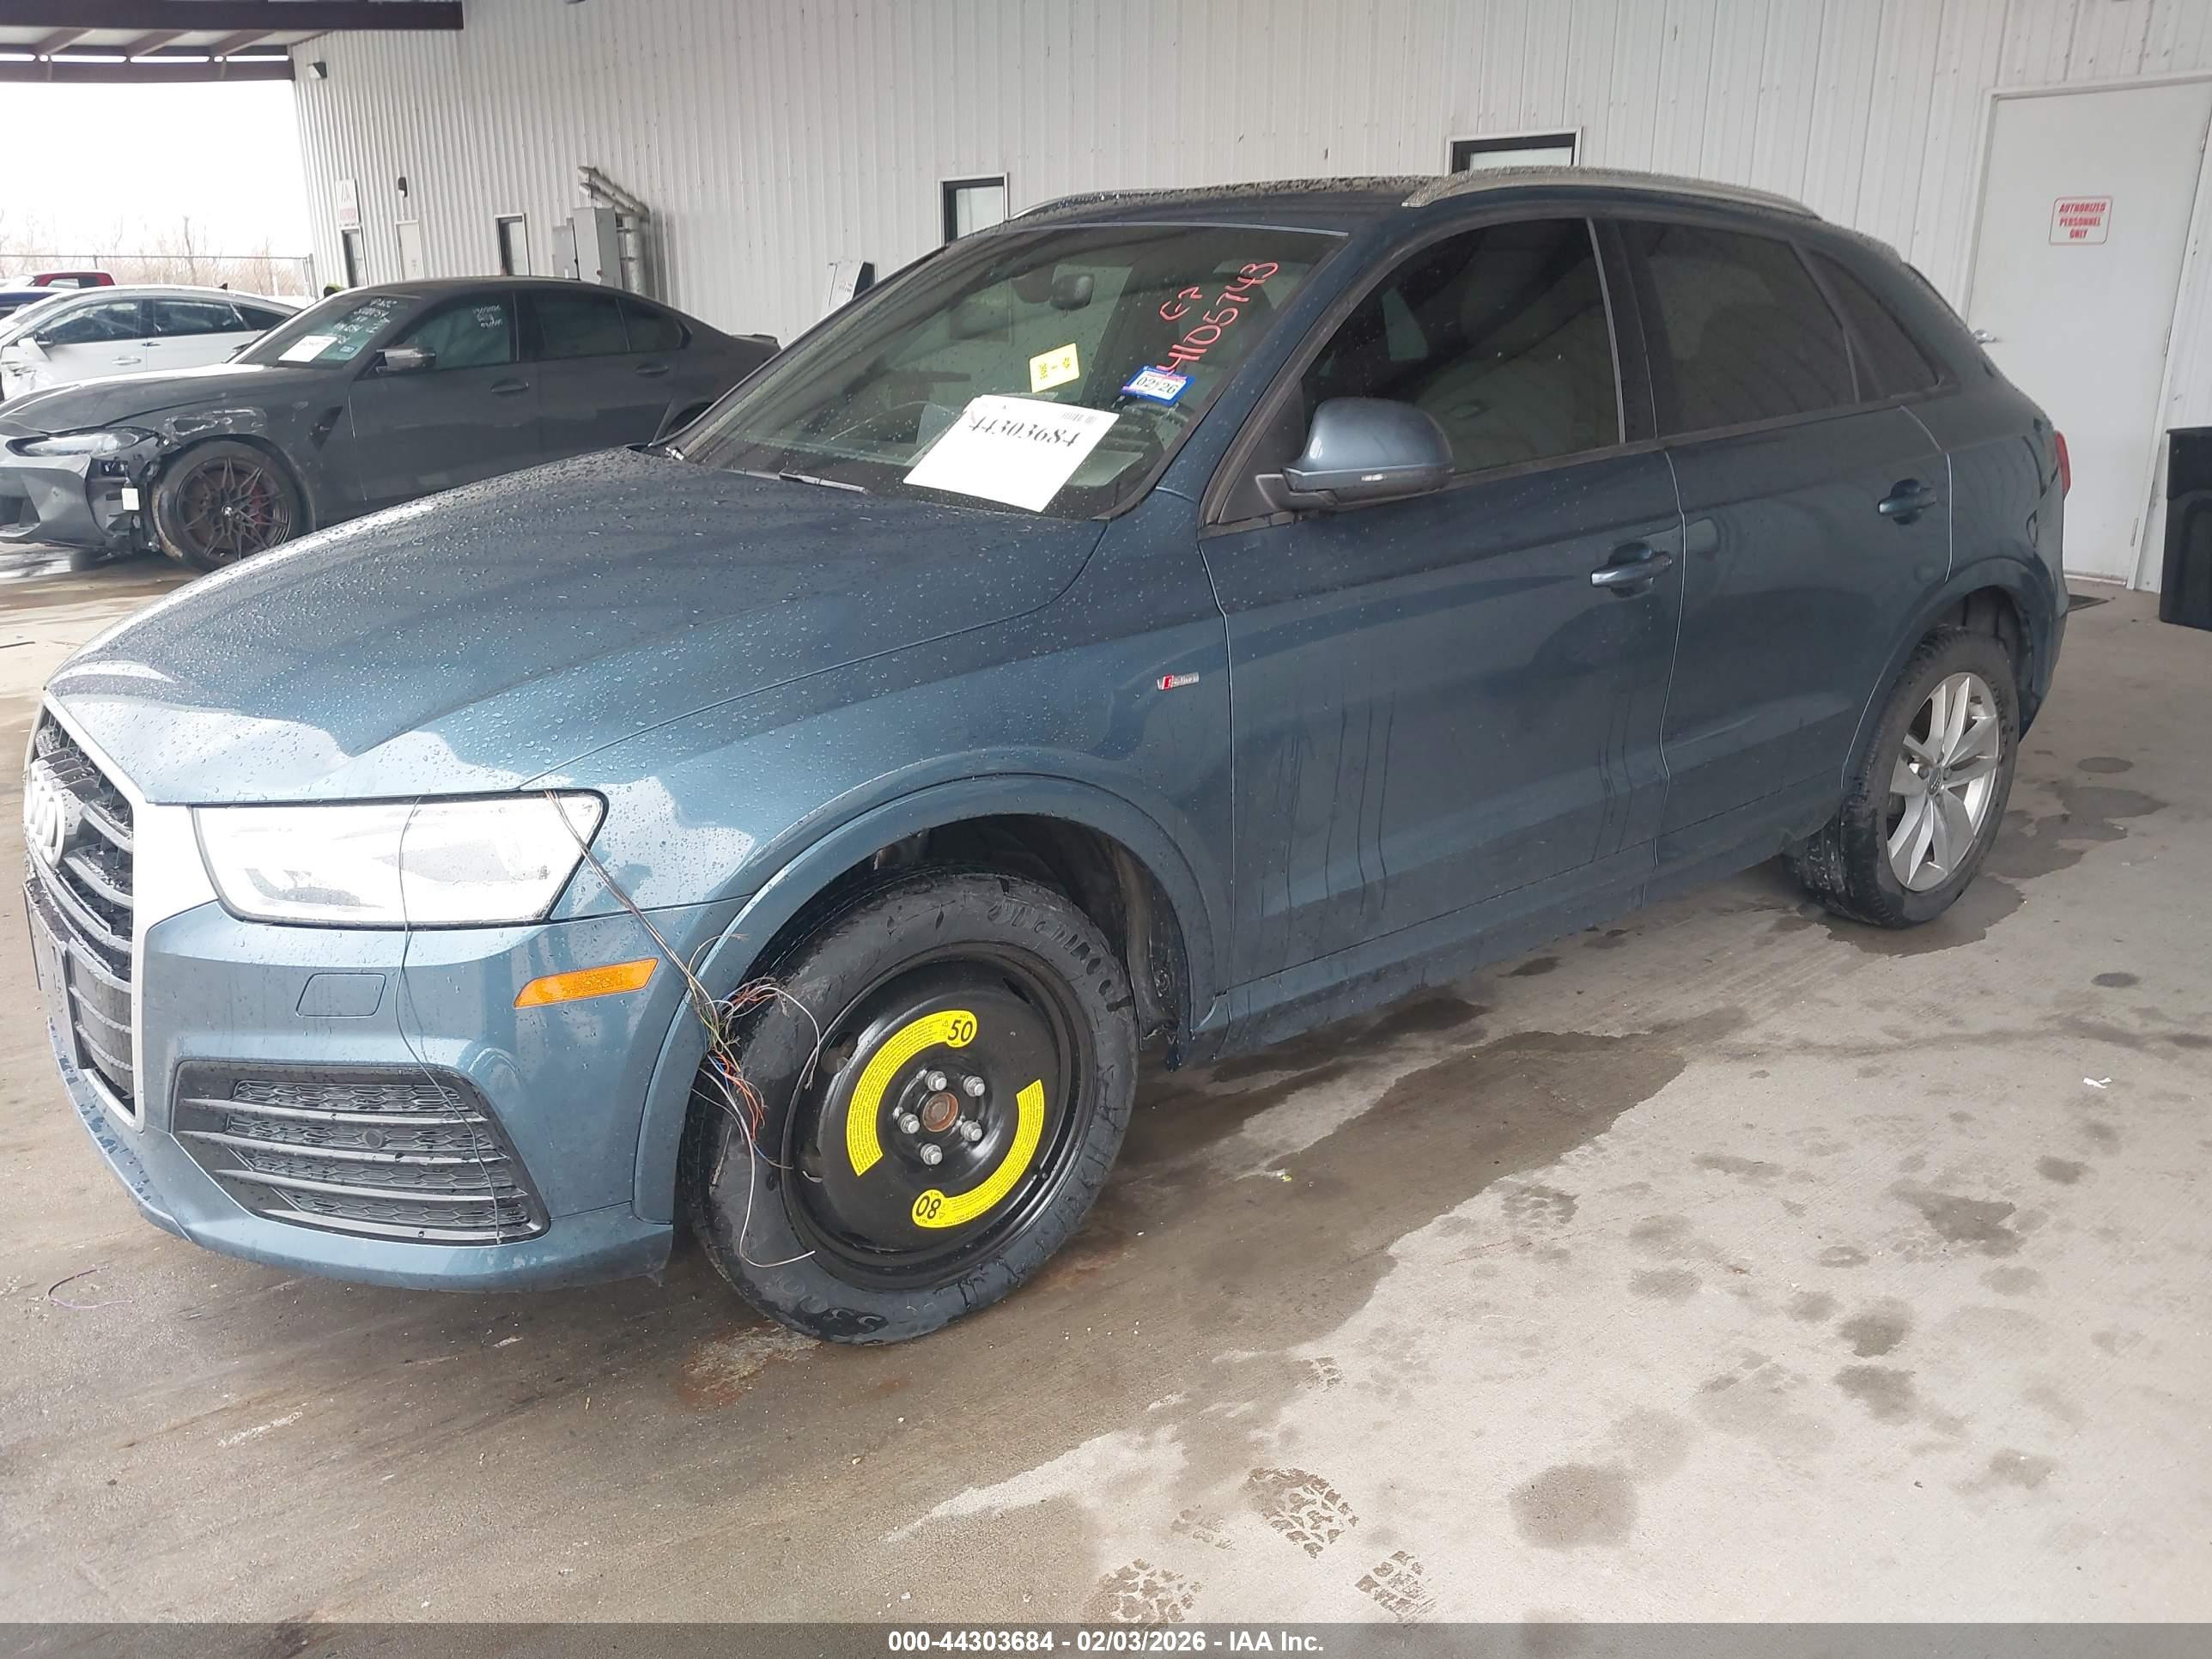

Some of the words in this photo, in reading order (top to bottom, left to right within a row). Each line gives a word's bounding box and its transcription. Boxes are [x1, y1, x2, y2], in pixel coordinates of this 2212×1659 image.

[2058, 202, 2106, 213] AUTHORIZED
[2059, 216, 2101, 227] PERSONNEL
[2069, 228, 2088, 239] ONLY
[1136, 376, 1156, 388] 02
[1158, 380, 1179, 394] 26
[968, 416, 1082, 447] 44303684
[947, 1018, 974, 1042] 50
